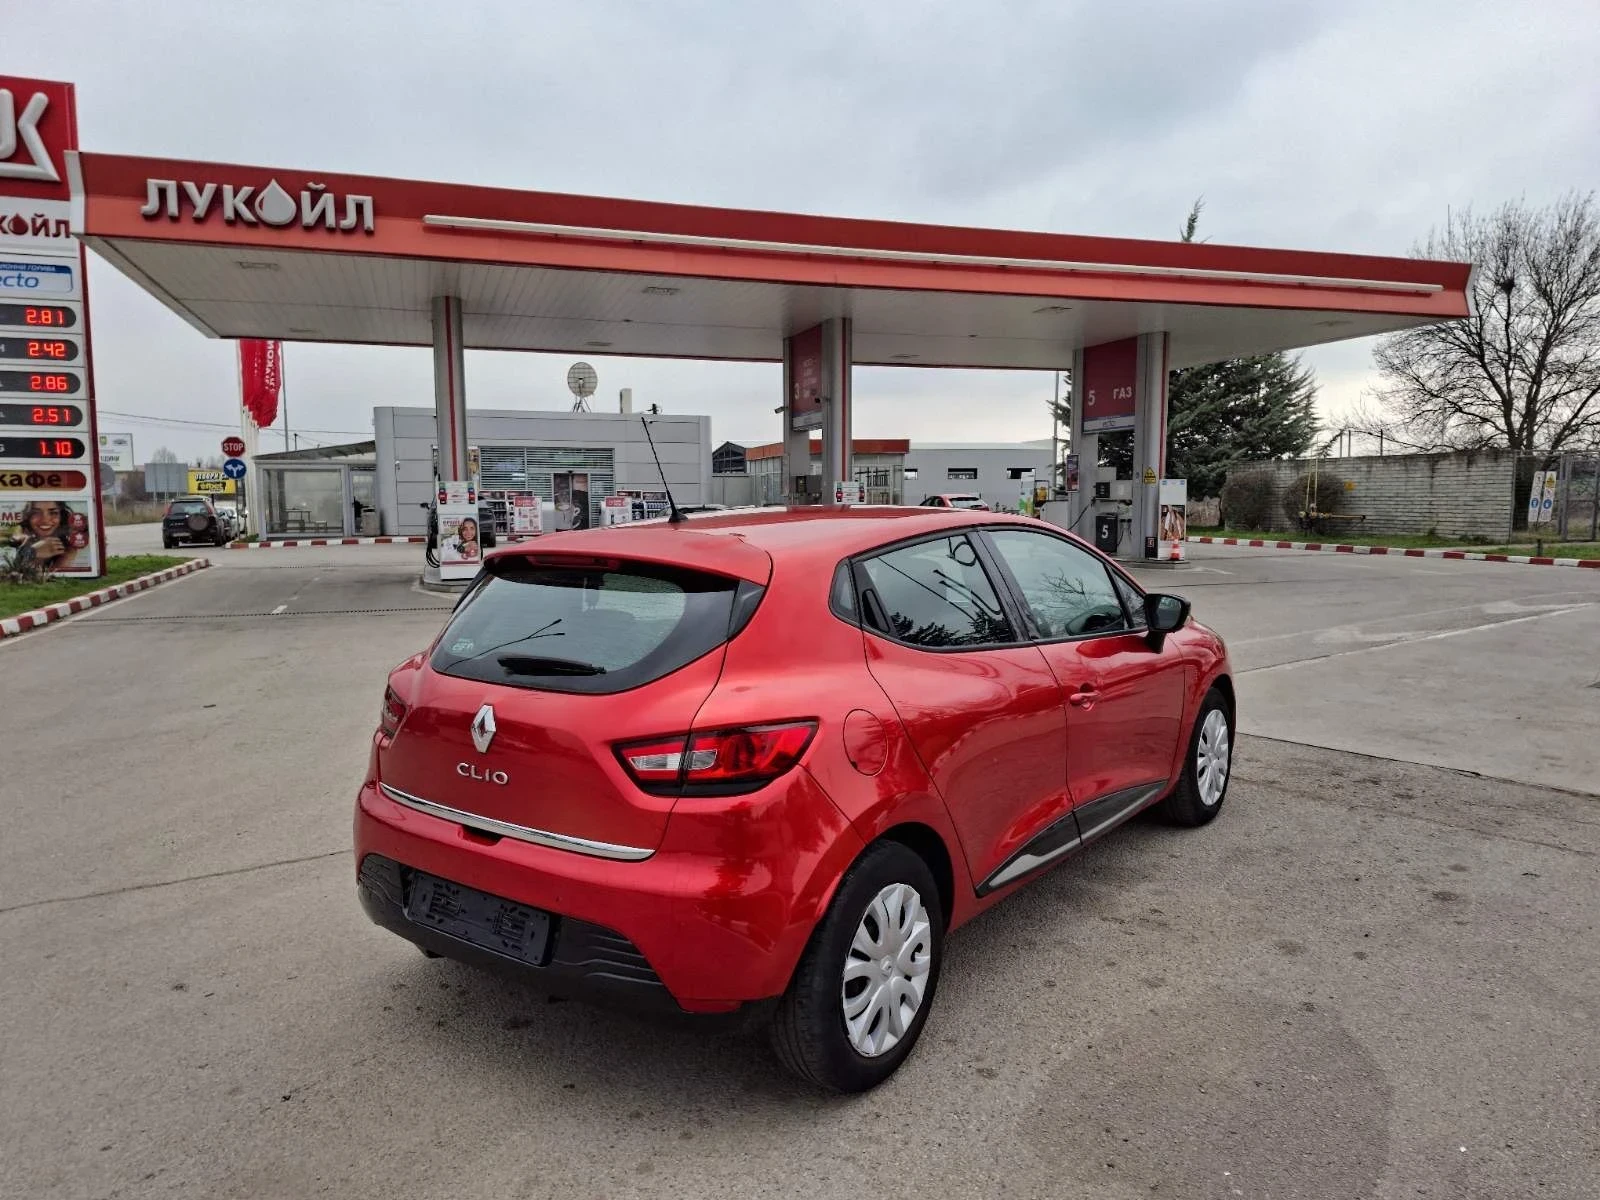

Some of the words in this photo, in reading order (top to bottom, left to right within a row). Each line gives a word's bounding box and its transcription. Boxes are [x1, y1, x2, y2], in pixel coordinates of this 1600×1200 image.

[140, 177, 375, 232] ЛУКОЙЛ
[0, 272, 39, 288] cto
[26, 309, 64, 324] 2.81
[28, 342, 66, 357] 2.42
[31, 375, 68, 391] 2.86
[1088, 389, 1096, 406] 5
[1112, 386, 1133, 400] ГАЗ
[32, 408, 70, 423] 2.51
[40, 441, 72, 456] 1.10
[223, 442, 244, 452] STOP
[1101, 524, 1109, 539] 5
[456, 762, 509, 785] CLIO
